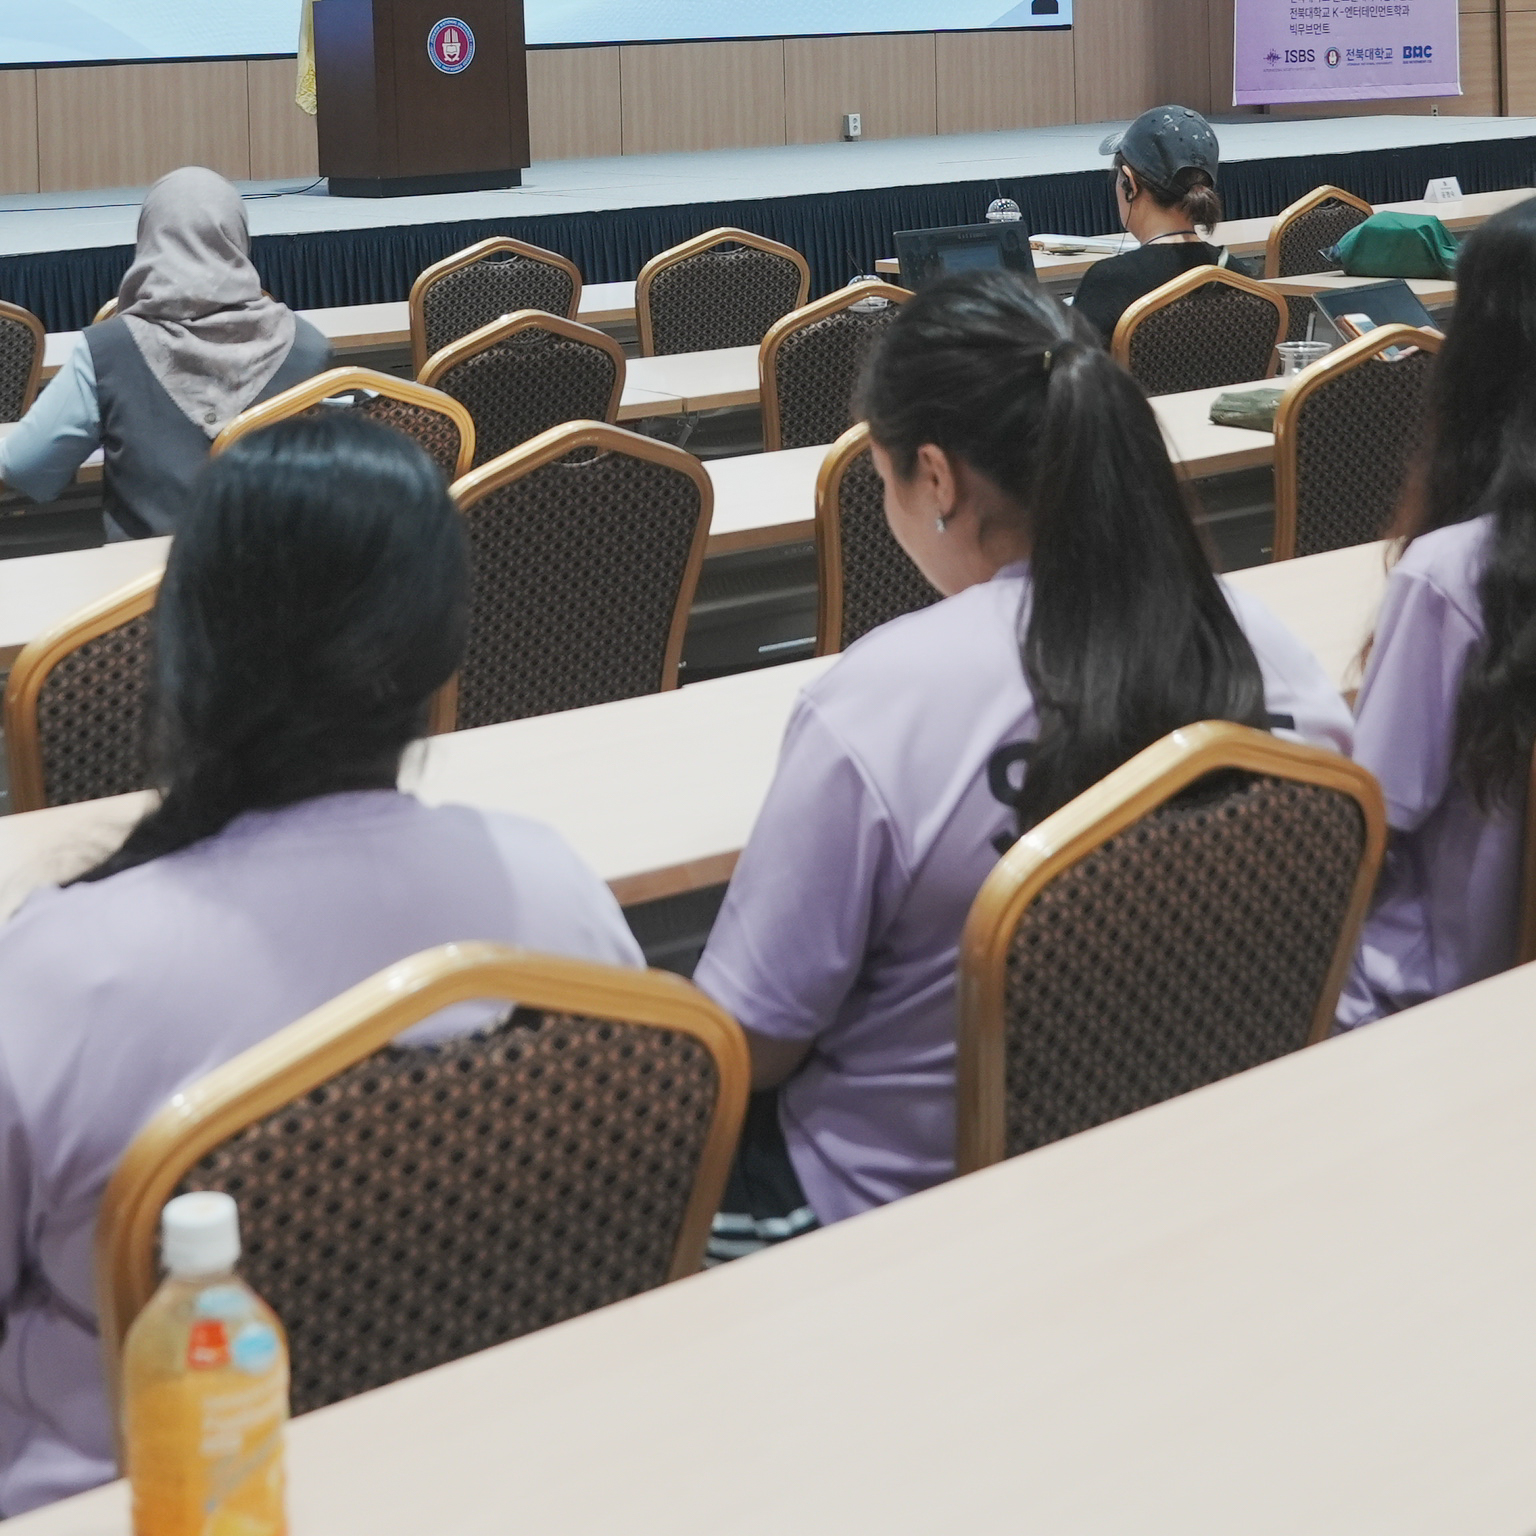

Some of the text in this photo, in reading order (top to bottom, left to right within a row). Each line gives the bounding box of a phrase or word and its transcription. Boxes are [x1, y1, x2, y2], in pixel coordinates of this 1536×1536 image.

[1290, 7, 1330, 20] 전북대학교
[1290, 22, 1331, 36] 빅무브먼트
[1284, 49, 1316, 63] ISBS
[1345, 47, 1394, 61] 전북대학교
[1402, 45, 1433, 59] BMC
